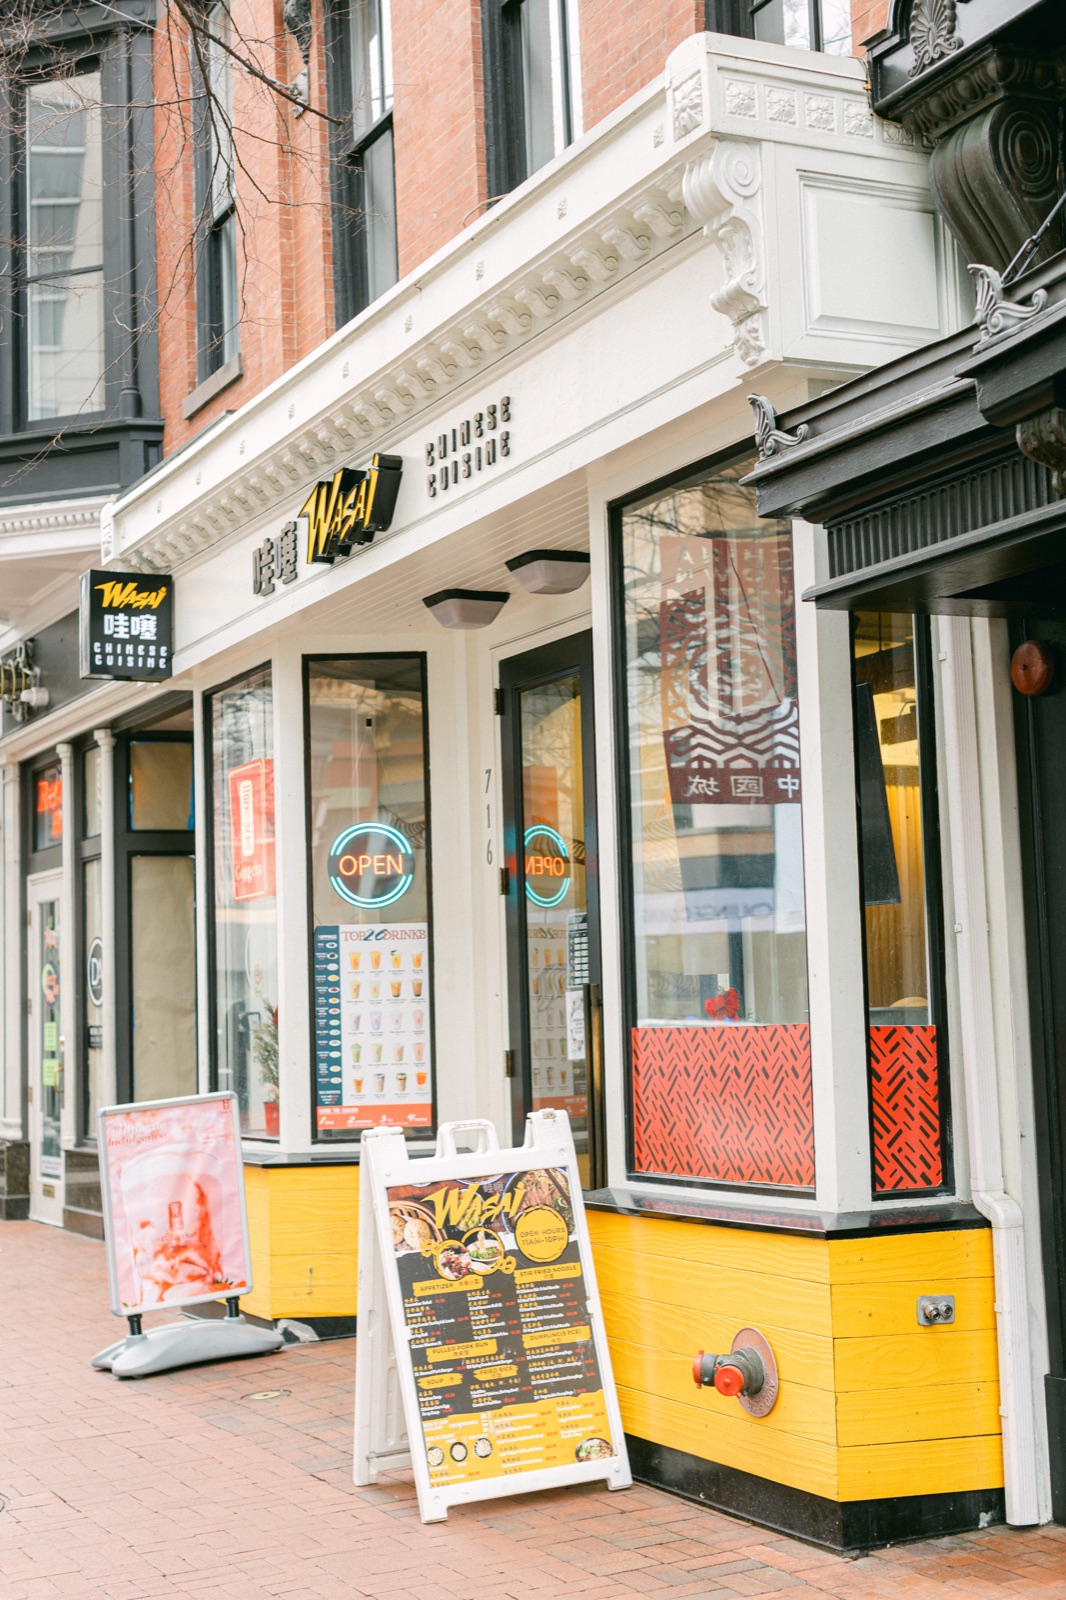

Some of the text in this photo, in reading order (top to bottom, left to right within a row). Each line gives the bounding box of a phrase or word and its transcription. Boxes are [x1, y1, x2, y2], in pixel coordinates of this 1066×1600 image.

[425, 396, 511, 467] CHINESE
[427, 431, 510, 498] CUISINE
[103, 613, 157, 640] 哇噻
[94, 642, 168, 657] CHINESE
[95, 654, 167, 669] CUISINE
[339, 853, 403, 876] OPEN
[341, 928, 427, 941] TOP 20 DRINKS
[520, 1226, 566, 1238] OPEN HOURS
[420, 1283, 454, 1292] APPETIZER
[432, 1346, 456, 1354] PULLED
[457, 1343, 475, 1351] PORK
